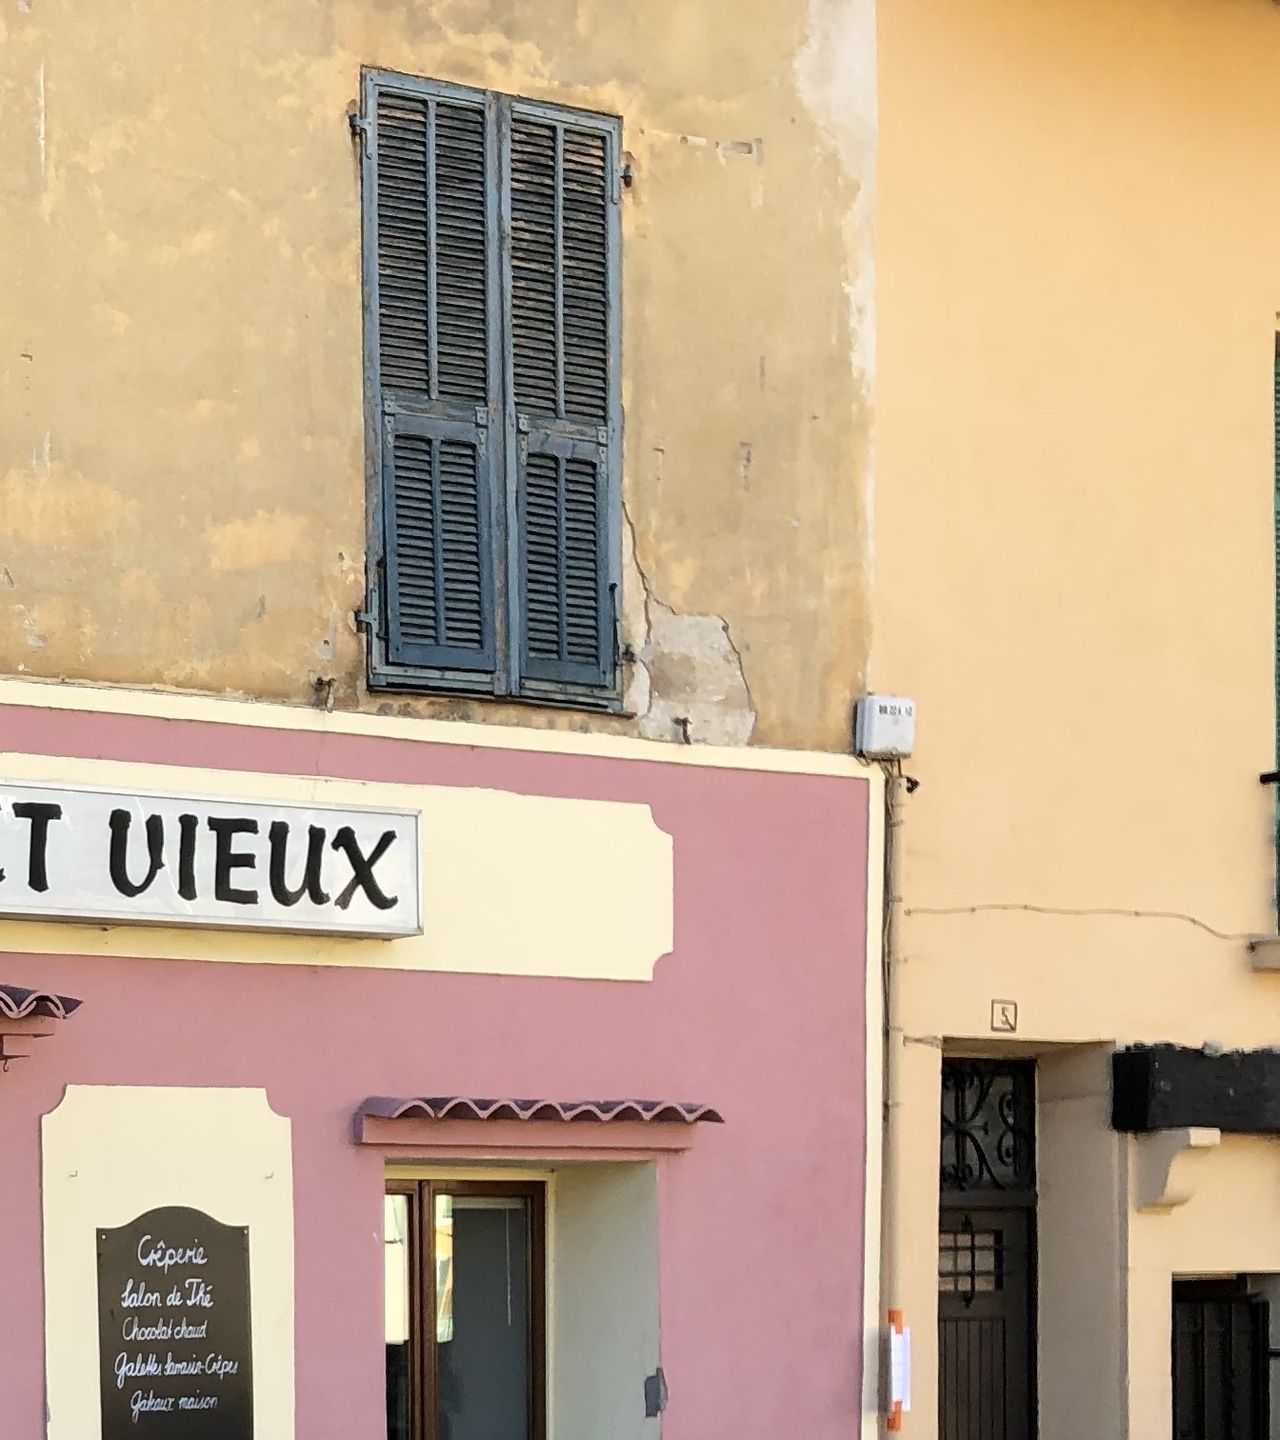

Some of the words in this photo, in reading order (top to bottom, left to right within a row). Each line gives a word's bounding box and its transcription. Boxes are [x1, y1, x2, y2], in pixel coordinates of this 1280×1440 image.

[108, 809, 399, 910] VIEUX
[137, 1234, 209, 1275] Crêperie
[120, 1278, 163, 1308] Salon
[166, 1285, 184, 1307] de
[184, 1278, 214, 1309] Thé
[122, 1316, 174, 1341] Chocolat
[173, 1316, 208, 1340] chaud
[178, 1389, 219, 1410] maison
